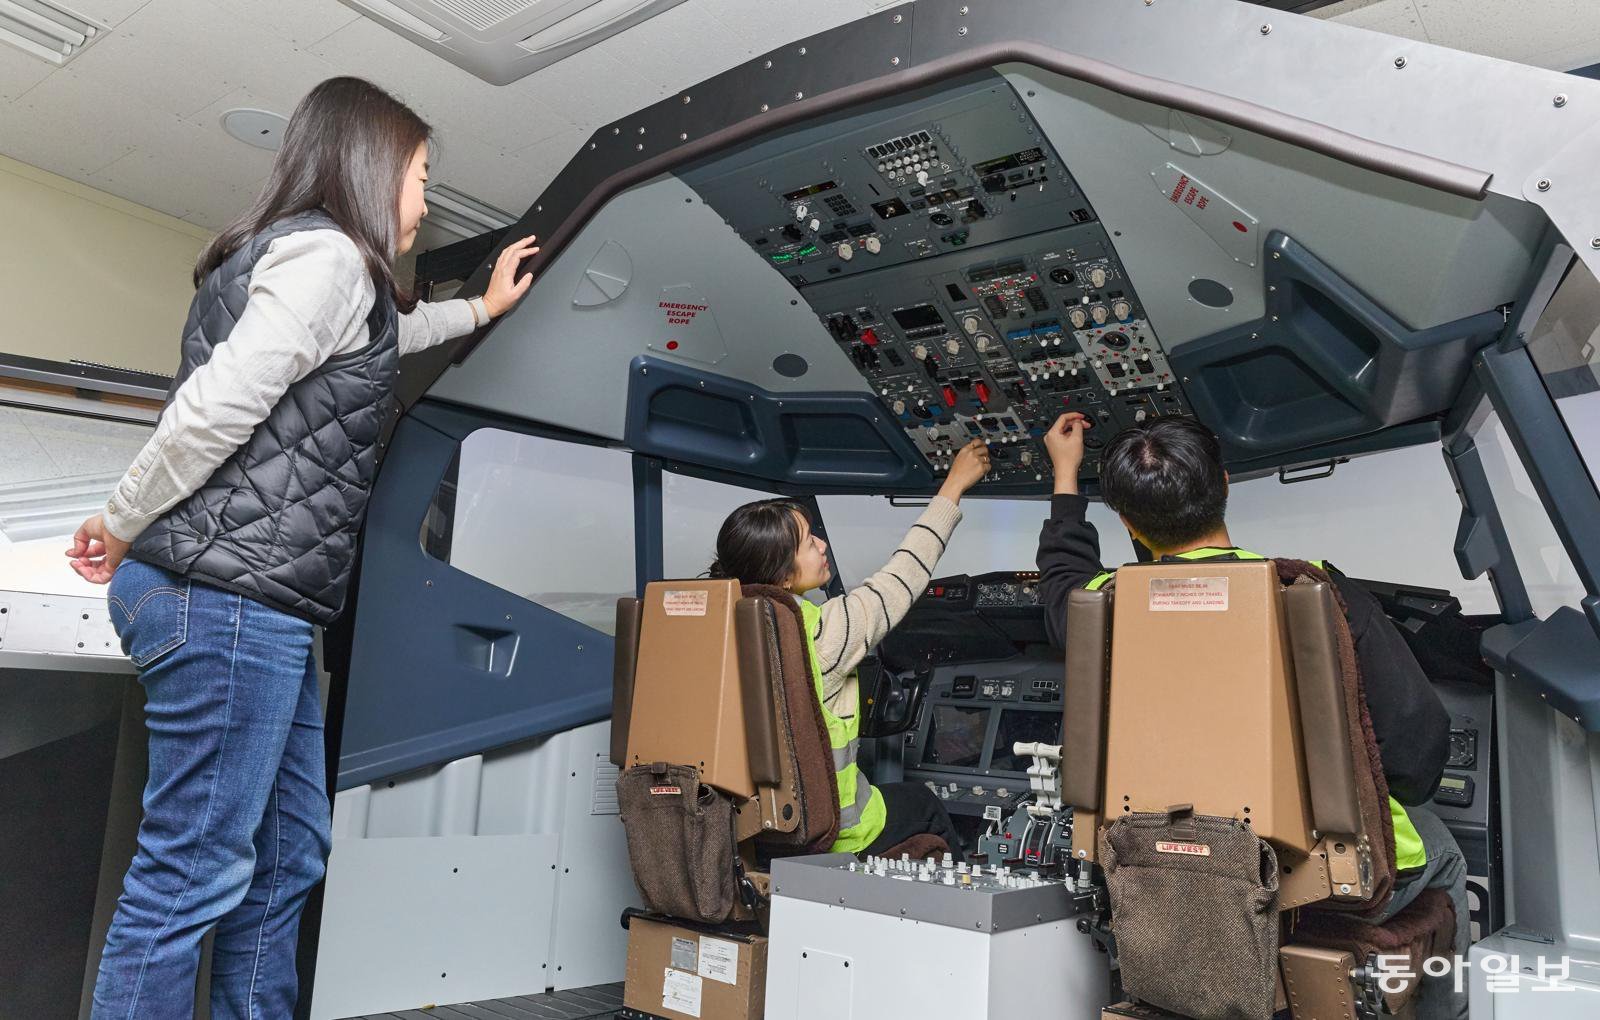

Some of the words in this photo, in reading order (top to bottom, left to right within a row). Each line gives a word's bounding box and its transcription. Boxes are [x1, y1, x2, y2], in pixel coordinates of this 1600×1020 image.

[1170, 174, 1190, 203] EMERGENCY
[1184, 186, 1199, 205] ESCAPE
[1196, 195, 1210, 210] ROPE
[658, 302, 708, 311] EMERGENCY
[668, 317, 690, 325] ROPE
[1162, 843, 1180, 851] LIFE
[1181, 845, 1204, 853] VEST
